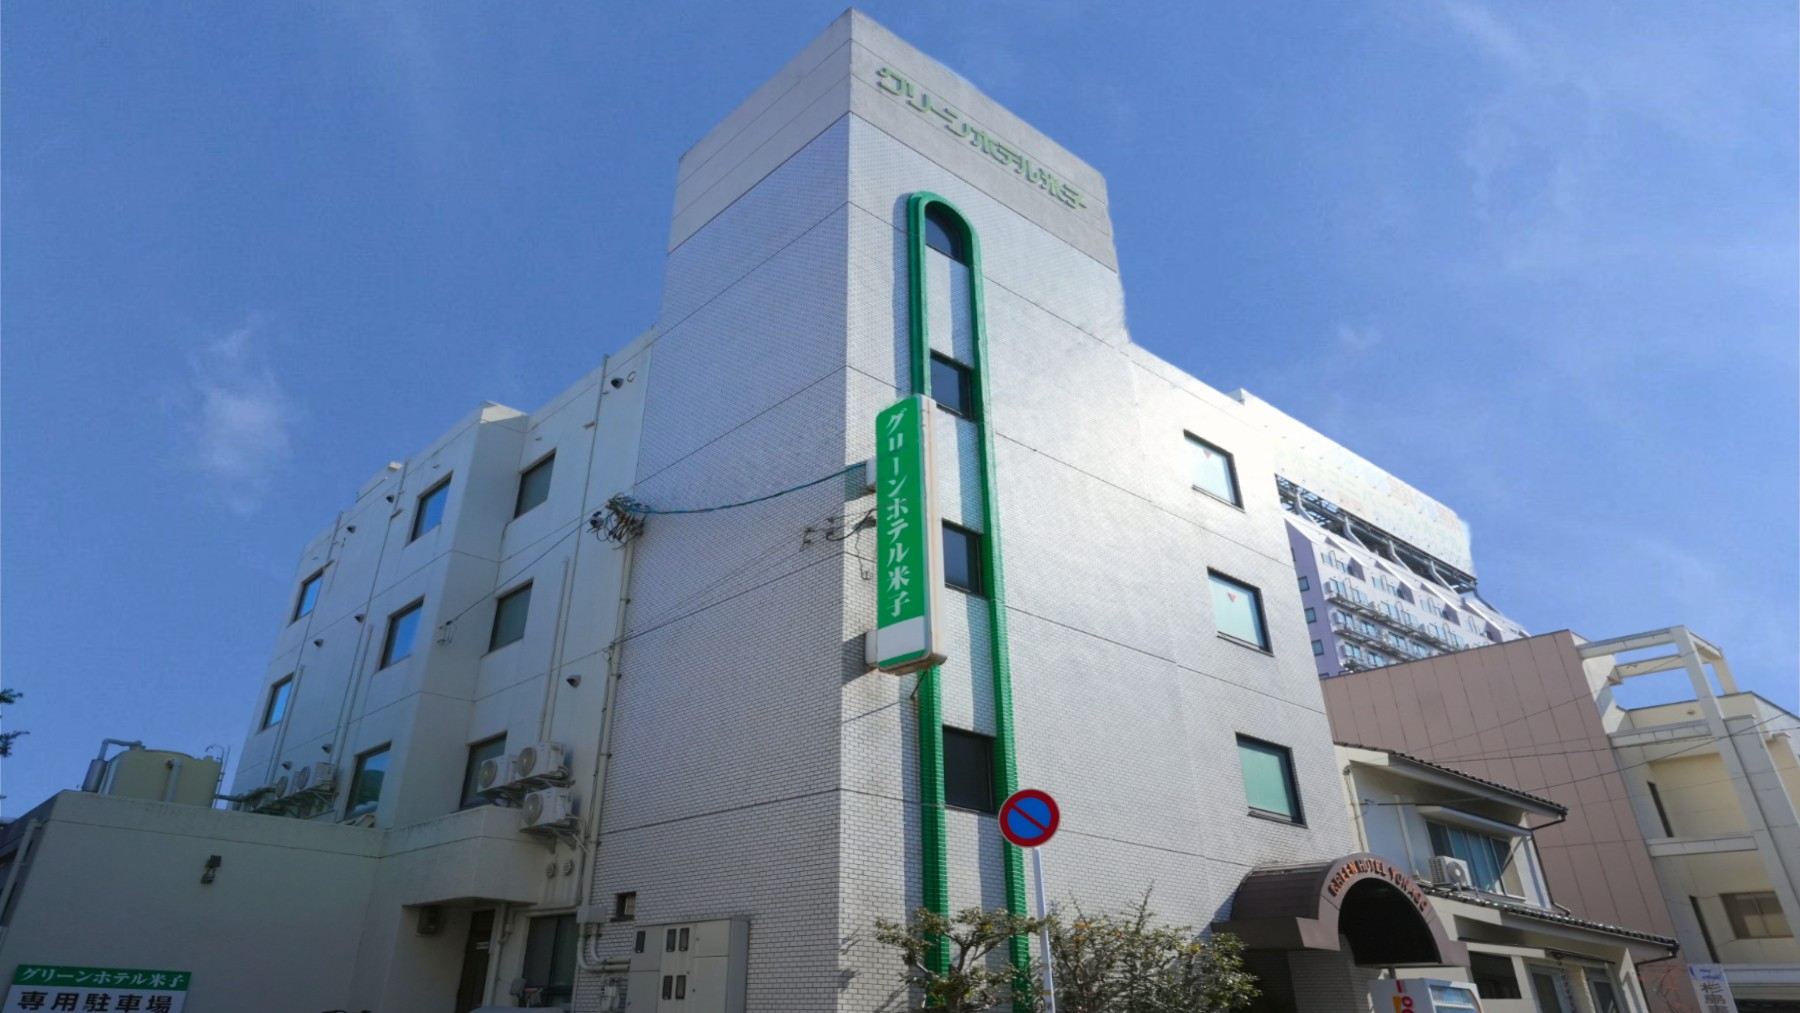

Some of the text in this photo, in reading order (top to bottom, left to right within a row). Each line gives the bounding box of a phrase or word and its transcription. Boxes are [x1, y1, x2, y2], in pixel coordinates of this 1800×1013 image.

[886, 408, 911, 618] グリーンホテル米子
[1327, 859, 1357, 897] GREEN
[1356, 858, 1387, 877] HOTEL
[20, 967, 185, 988] グリーンホテル米子
[17, 991, 173, 1013] 専用駐車場
